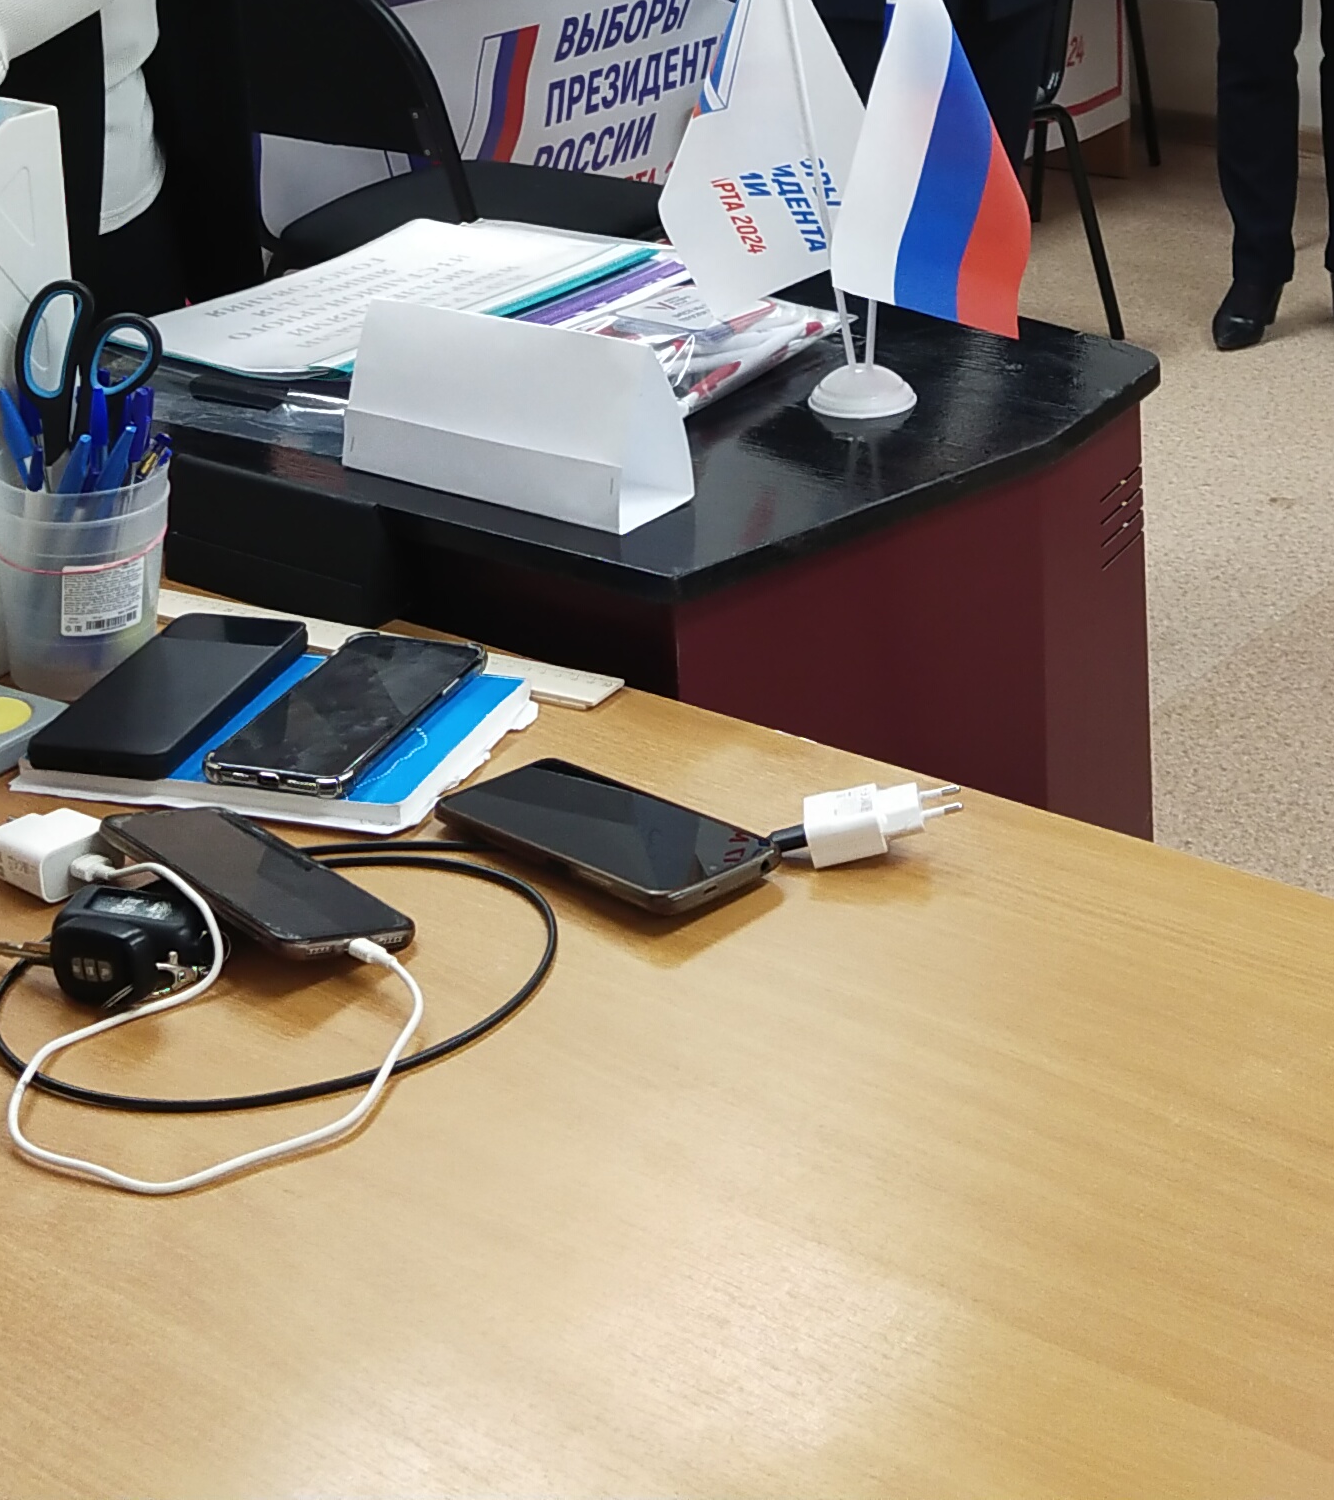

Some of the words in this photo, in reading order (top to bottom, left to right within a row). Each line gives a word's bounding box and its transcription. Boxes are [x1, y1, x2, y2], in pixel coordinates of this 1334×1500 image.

[544, 35, 722, 128] ПРЕЗИДЕНТ
[711, 177, 746, 212] РТА
[730, 215, 767, 255] 2024
